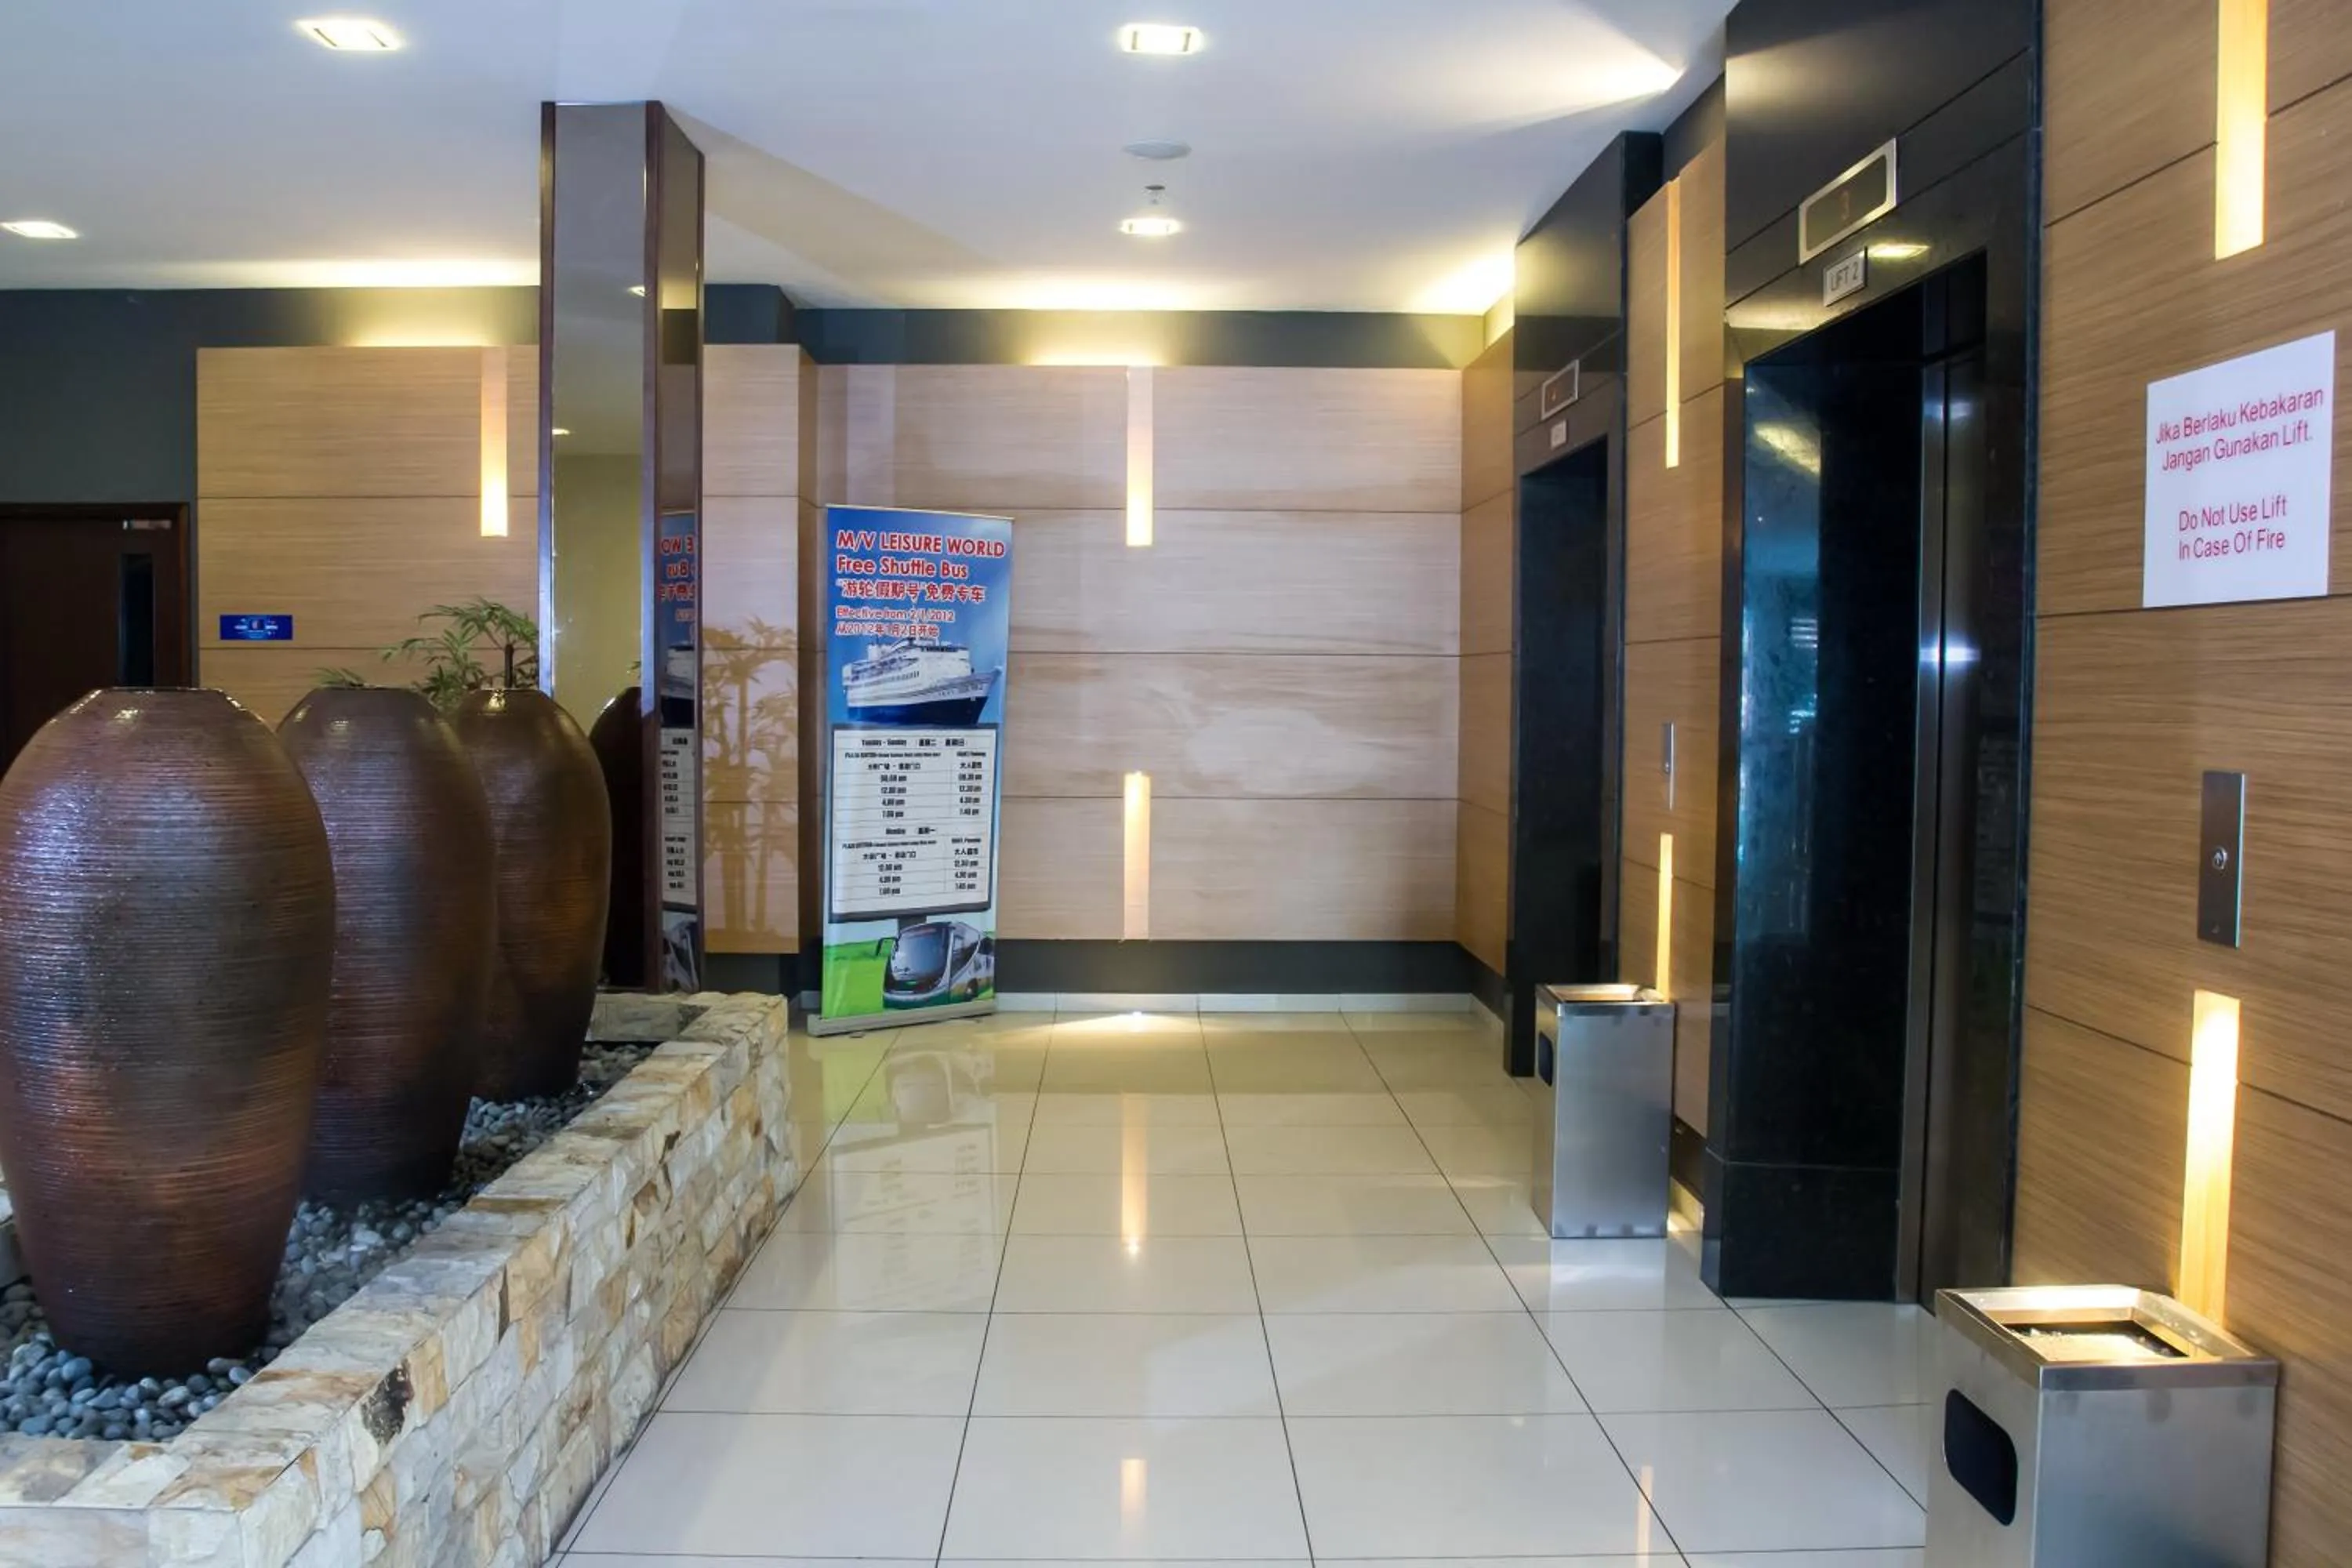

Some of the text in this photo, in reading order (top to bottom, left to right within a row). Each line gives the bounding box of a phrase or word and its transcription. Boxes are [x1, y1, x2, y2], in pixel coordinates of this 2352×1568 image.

[1853, 261, 1858, 281] 2
[2156, 389, 2324, 444] Jika Berlaku Kebakaran
[2162, 446, 2210, 471] Jangan
[2214, 428, 2278, 460] Gunakan
[2179, 495, 2287, 532] Do Not Use Lift
[837, 530, 1004, 557] M/V LEISURE WORLD
[2179, 528, 2285, 561] In Case Of Fire
[837, 556, 968, 578] Free Shuttle Bus
[837, 607, 882, 619] Effective
